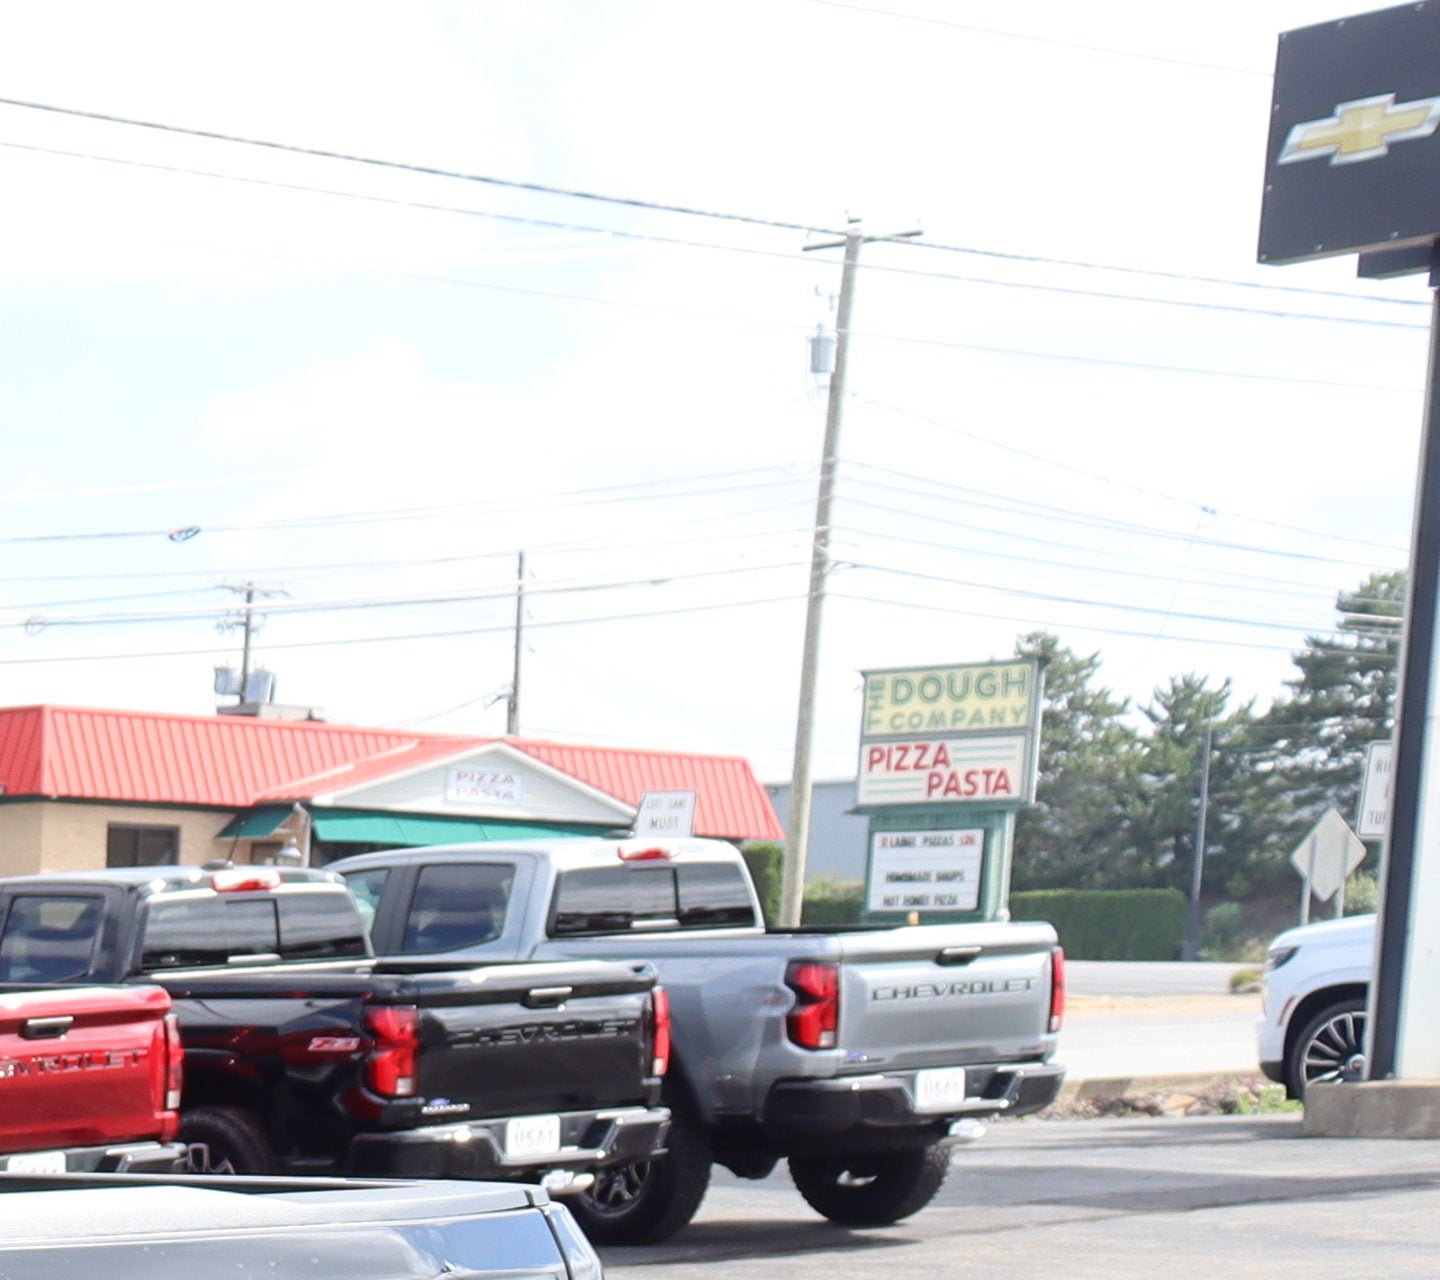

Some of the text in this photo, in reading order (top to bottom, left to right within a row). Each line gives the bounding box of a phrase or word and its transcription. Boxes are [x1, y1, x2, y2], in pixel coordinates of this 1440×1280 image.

[890, 668, 1030, 706] DOUGH
[868, 678, 885, 731] THE
[889, 705, 1027, 730] COMPANY
[868, 742, 951, 773] PIZZA
[455, 769, 516, 784] PIZZA
[927, 767, 1012, 798] PASTA
[456, 788, 515, 800] PASTA
[650, 815, 680, 830] MUST
[872, 978, 1037, 1000] CHEVROLET
[450, 1019, 637, 1050] CHEVROLET
